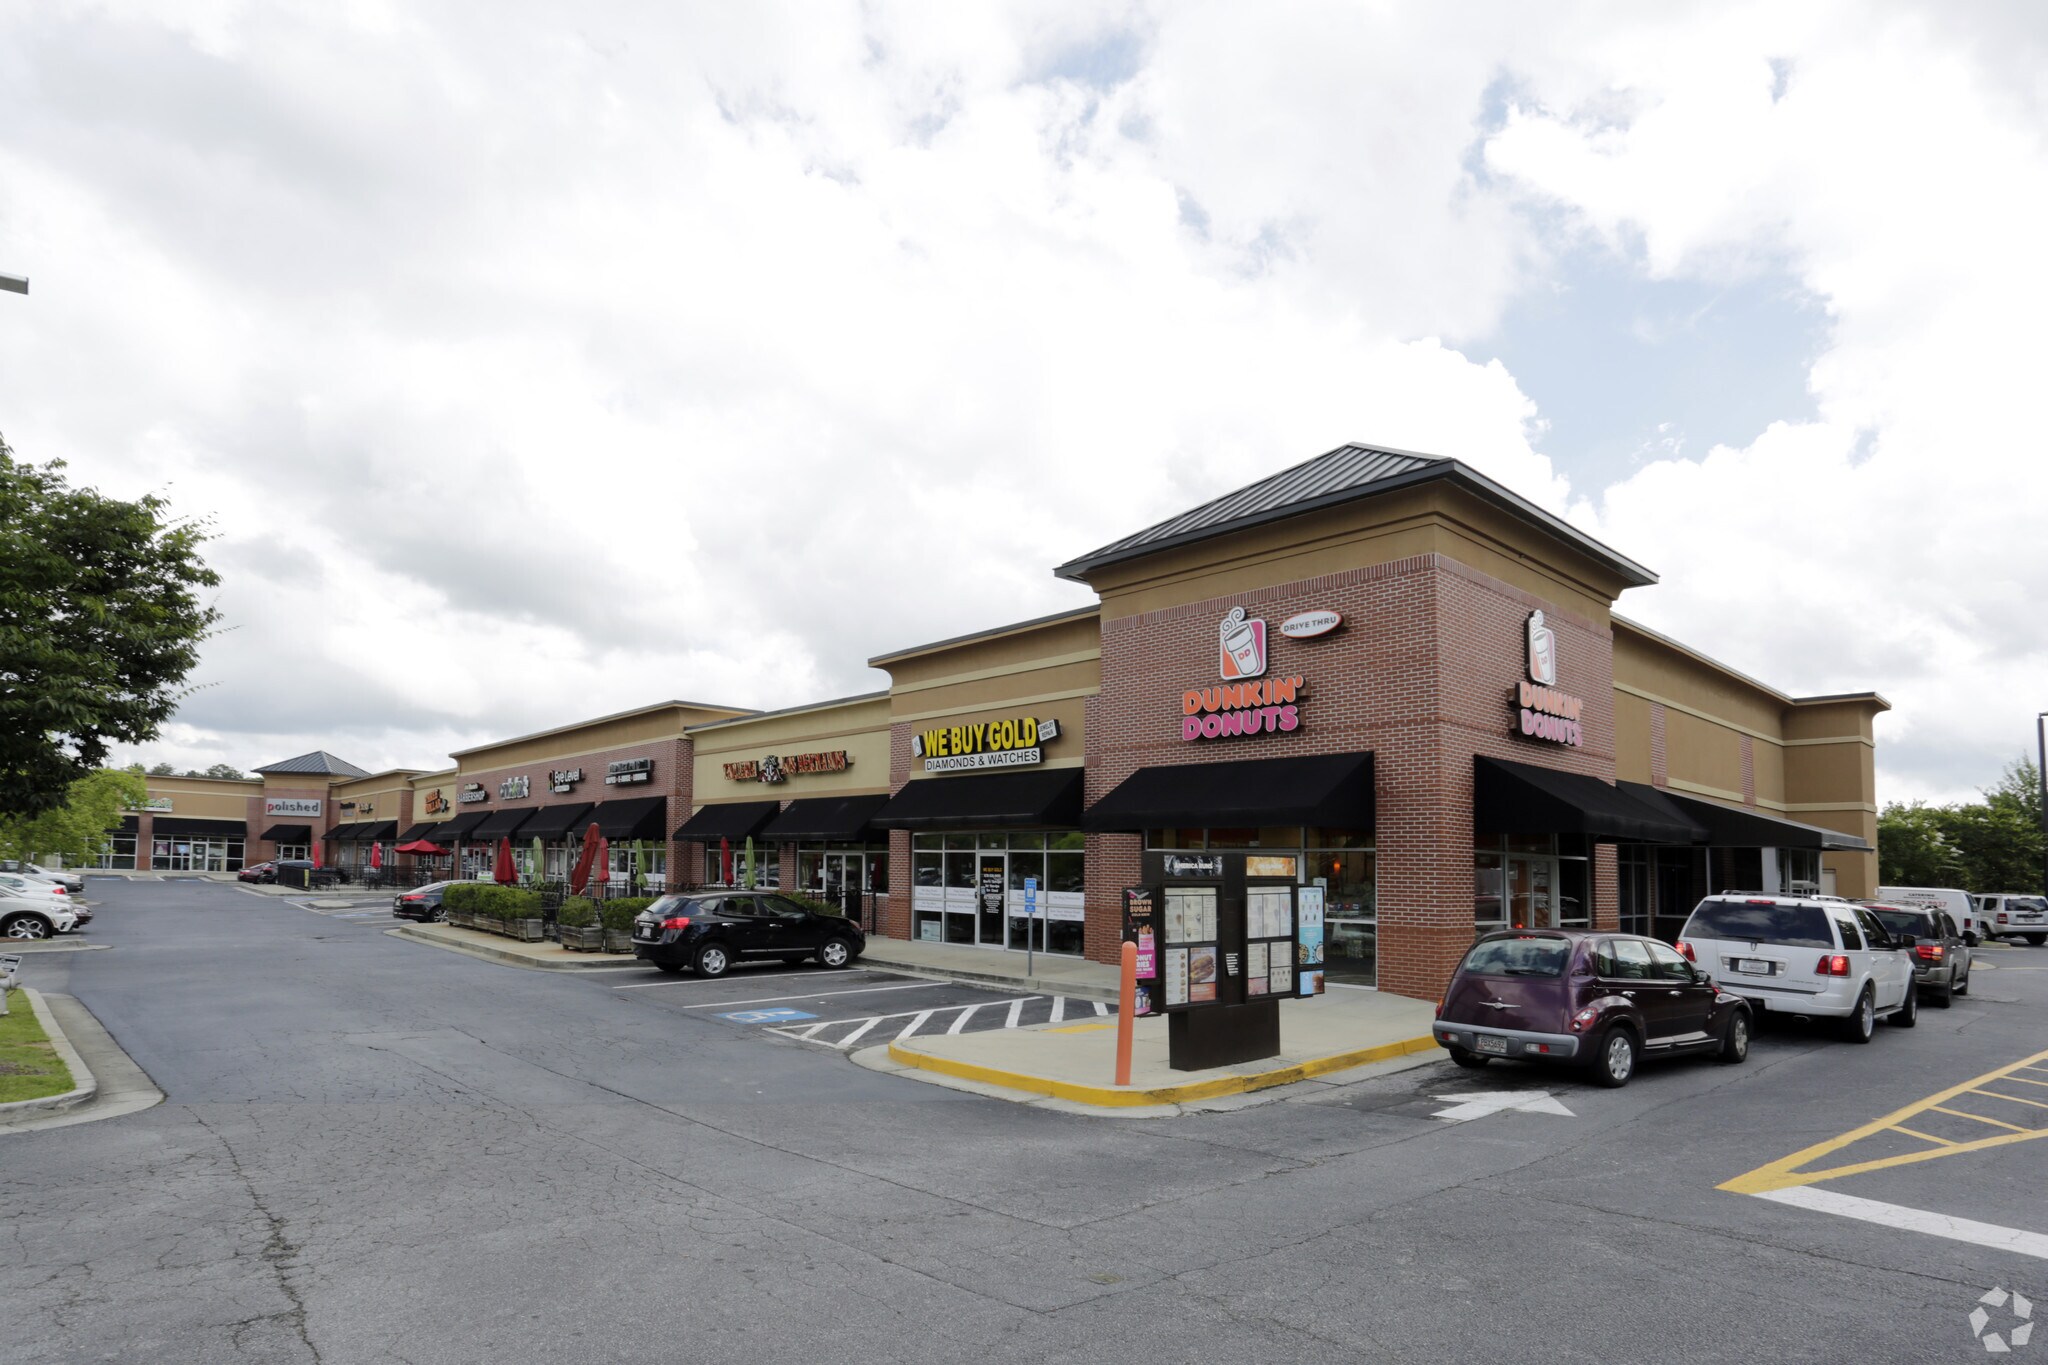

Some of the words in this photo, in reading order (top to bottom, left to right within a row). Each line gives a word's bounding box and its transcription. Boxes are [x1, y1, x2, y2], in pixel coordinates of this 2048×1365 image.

[1283, 621, 1310, 632] DRIVE
[1311, 616, 1337, 627] THRU
[1238, 648, 1251, 661] DD
[1183, 675, 1304, 715] DUNKIN'
[1519, 681, 1583, 721] DUNKIN'
[1039, 721, 1054, 732] JEWELRY
[1183, 705, 1298, 741] DONUTS
[1520, 708, 1583, 747] DONUTS
[924, 728, 949, 757] WE
[951, 723, 985, 755] BUY
[989, 717, 1037, 751] GOLD
[1041, 729, 1054, 739] REPAIR
[926, 756, 976, 771] DIAMONDS
[978, 755, 985, 766] &
[987, 750, 1038, 765] WATCHES
[554, 771, 565, 786] Eye
[565, 770, 580, 782] Level
[457, 790, 486, 803] BARBERSHOP
[267, 801, 319, 813] polished
[1129, 905, 1152, 913] SUGAR
